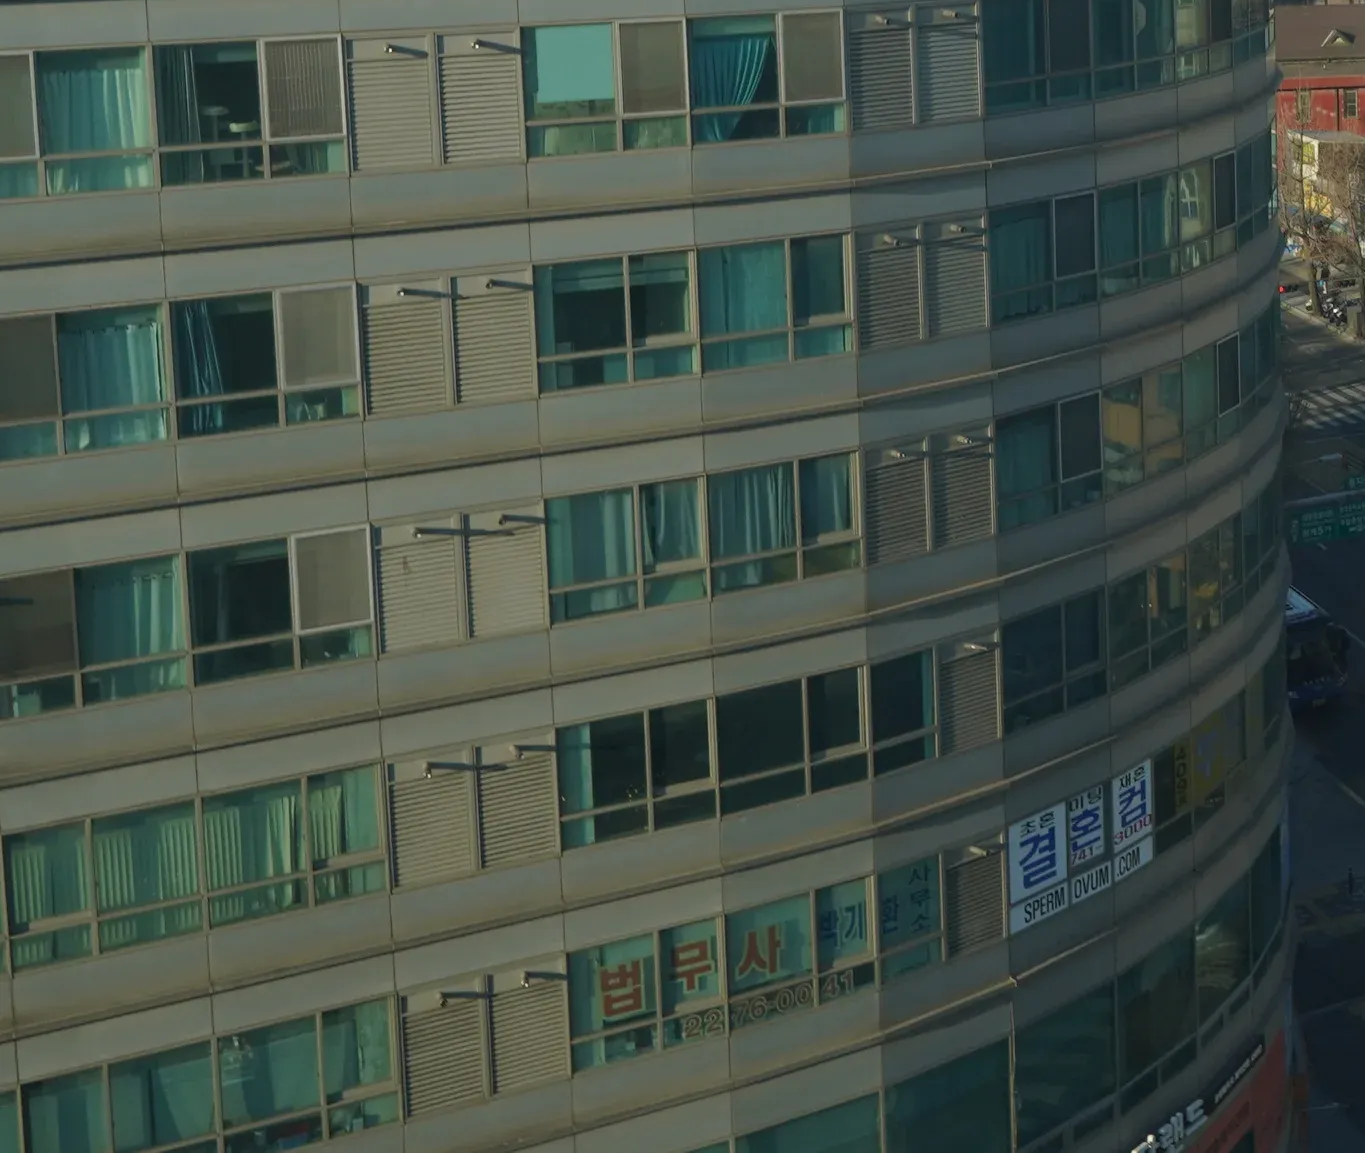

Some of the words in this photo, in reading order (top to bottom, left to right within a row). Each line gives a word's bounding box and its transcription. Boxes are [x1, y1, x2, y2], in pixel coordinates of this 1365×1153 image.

[1019, 811, 1056, 837] 초혼
[1067, 785, 1103, 812] 미팅
[1119, 765, 1147, 789] 재혼
[907, 863, 932, 936] 사무소
[1023, 887, 1066, 924] SPERM
[1072, 865, 1110, 900] OVUM
